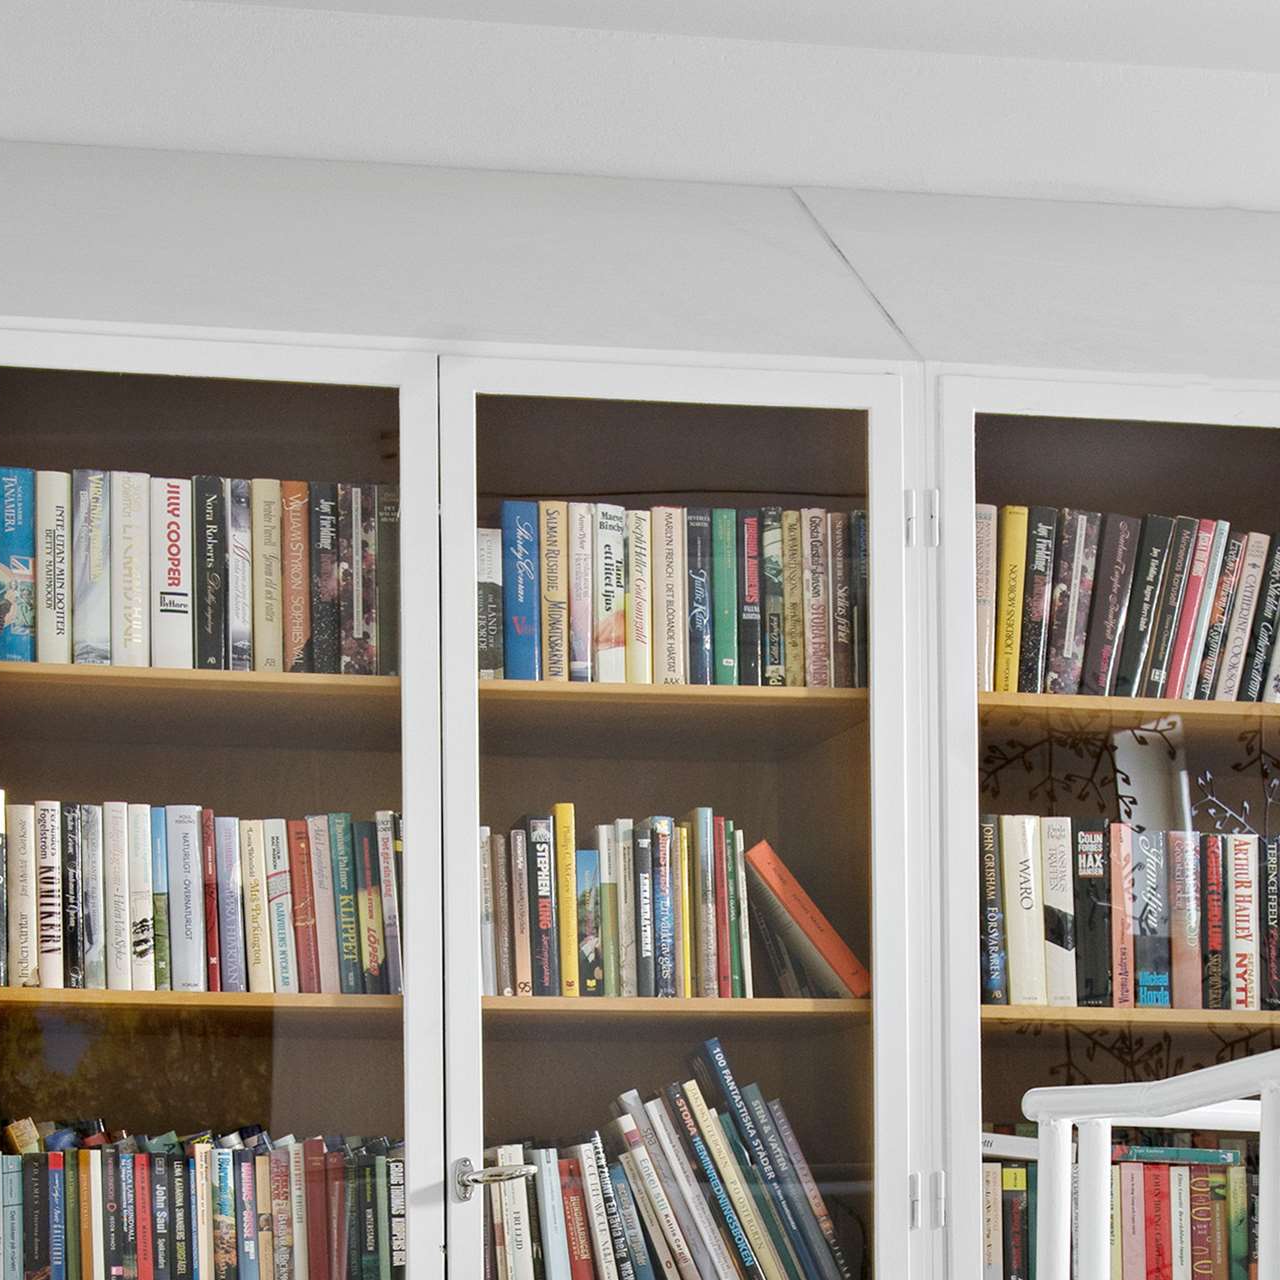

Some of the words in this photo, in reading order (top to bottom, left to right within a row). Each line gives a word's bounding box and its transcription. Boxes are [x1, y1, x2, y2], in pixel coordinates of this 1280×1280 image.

[3, 476, 16, 532] TANAMERA
[167, 483, 180, 517] JILLY
[206, 494, 217, 520] Nora
[56, 506, 64, 530] INTE
[316, 516, 335, 550] Fielding
[546, 509, 558, 546] SALMAN
[633, 513, 646, 543] Joseph
[665, 512, 673, 545] MARILYN
[56, 535, 64, 565] UTAN
[167, 521, 180, 587] COOPER
[206, 525, 217, 568] Roberts
[603, 544, 614, 560] ett
[635, 544, 646, 576] Heller
[290, 543, 302, 588] STYRON
[517, 559, 534, 603] Conran
[545, 549, 560, 591] RUSHDIE
[604, 562, 614, 586] litet
[603, 590, 615, 611] ljus
[666, 583, 674, 597] DET
[291, 596, 303, 643] SOPHIES
[488, 604, 497, 634] LAND
[811, 604, 825, 638] STORA
[812, 642, 827, 686] FAMNEN
[1223, 636, 1245, 696] COOKSON
[38, 808, 50, 859] Fogelström
[982, 824, 996, 850] JOHN
[1078, 831, 1103, 844] COLIN
[182, 832, 191, 874] NATURLIGT
[537, 843, 550, 896] STEPHEN
[1234, 839, 1252, 890] ARTHUR
[1267, 842, 1278, 893] TERENCE
[983, 853, 996, 899] GRISHAM
[183, 879, 193, 940] ÖVERNATURLIGT
[538, 898, 552, 929] KING
[1234, 894, 1253, 942] HAILEY
[1268, 895, 1278, 928] FEELY
[251, 903, 263, 966] Parkington
[339, 894, 358, 961] KLIPPET
[1236, 952, 1248, 1008] NYTT
[712, 1047, 727, 1069] 100
[722, 1064, 757, 1137] FANTASTISKA
[750, 1135, 776, 1181] STÄDER
[642, 1126, 657, 1147] spa
[750, 1099, 765, 1121] STEN
[764, 1128, 787, 1173] VATTEN
[174, 1161, 183, 1176] LENA
[390, 1162, 403, 1184] CRAIG
[675, 1097, 697, 1136] STORA
[692, 1135, 754, 1269] HEMINREDNINGSBOKEN
[155, 1184, 166, 1208] John
[174, 1177, 183, 1207] KATARINA
[391, 1186, 404, 1215] THOMAS
[639, 1157, 657, 1187] Enkel
[653, 1188, 670, 1218] stil
[157, 1211, 168, 1233] Saul
[614, 1238, 628, 1258] helg
